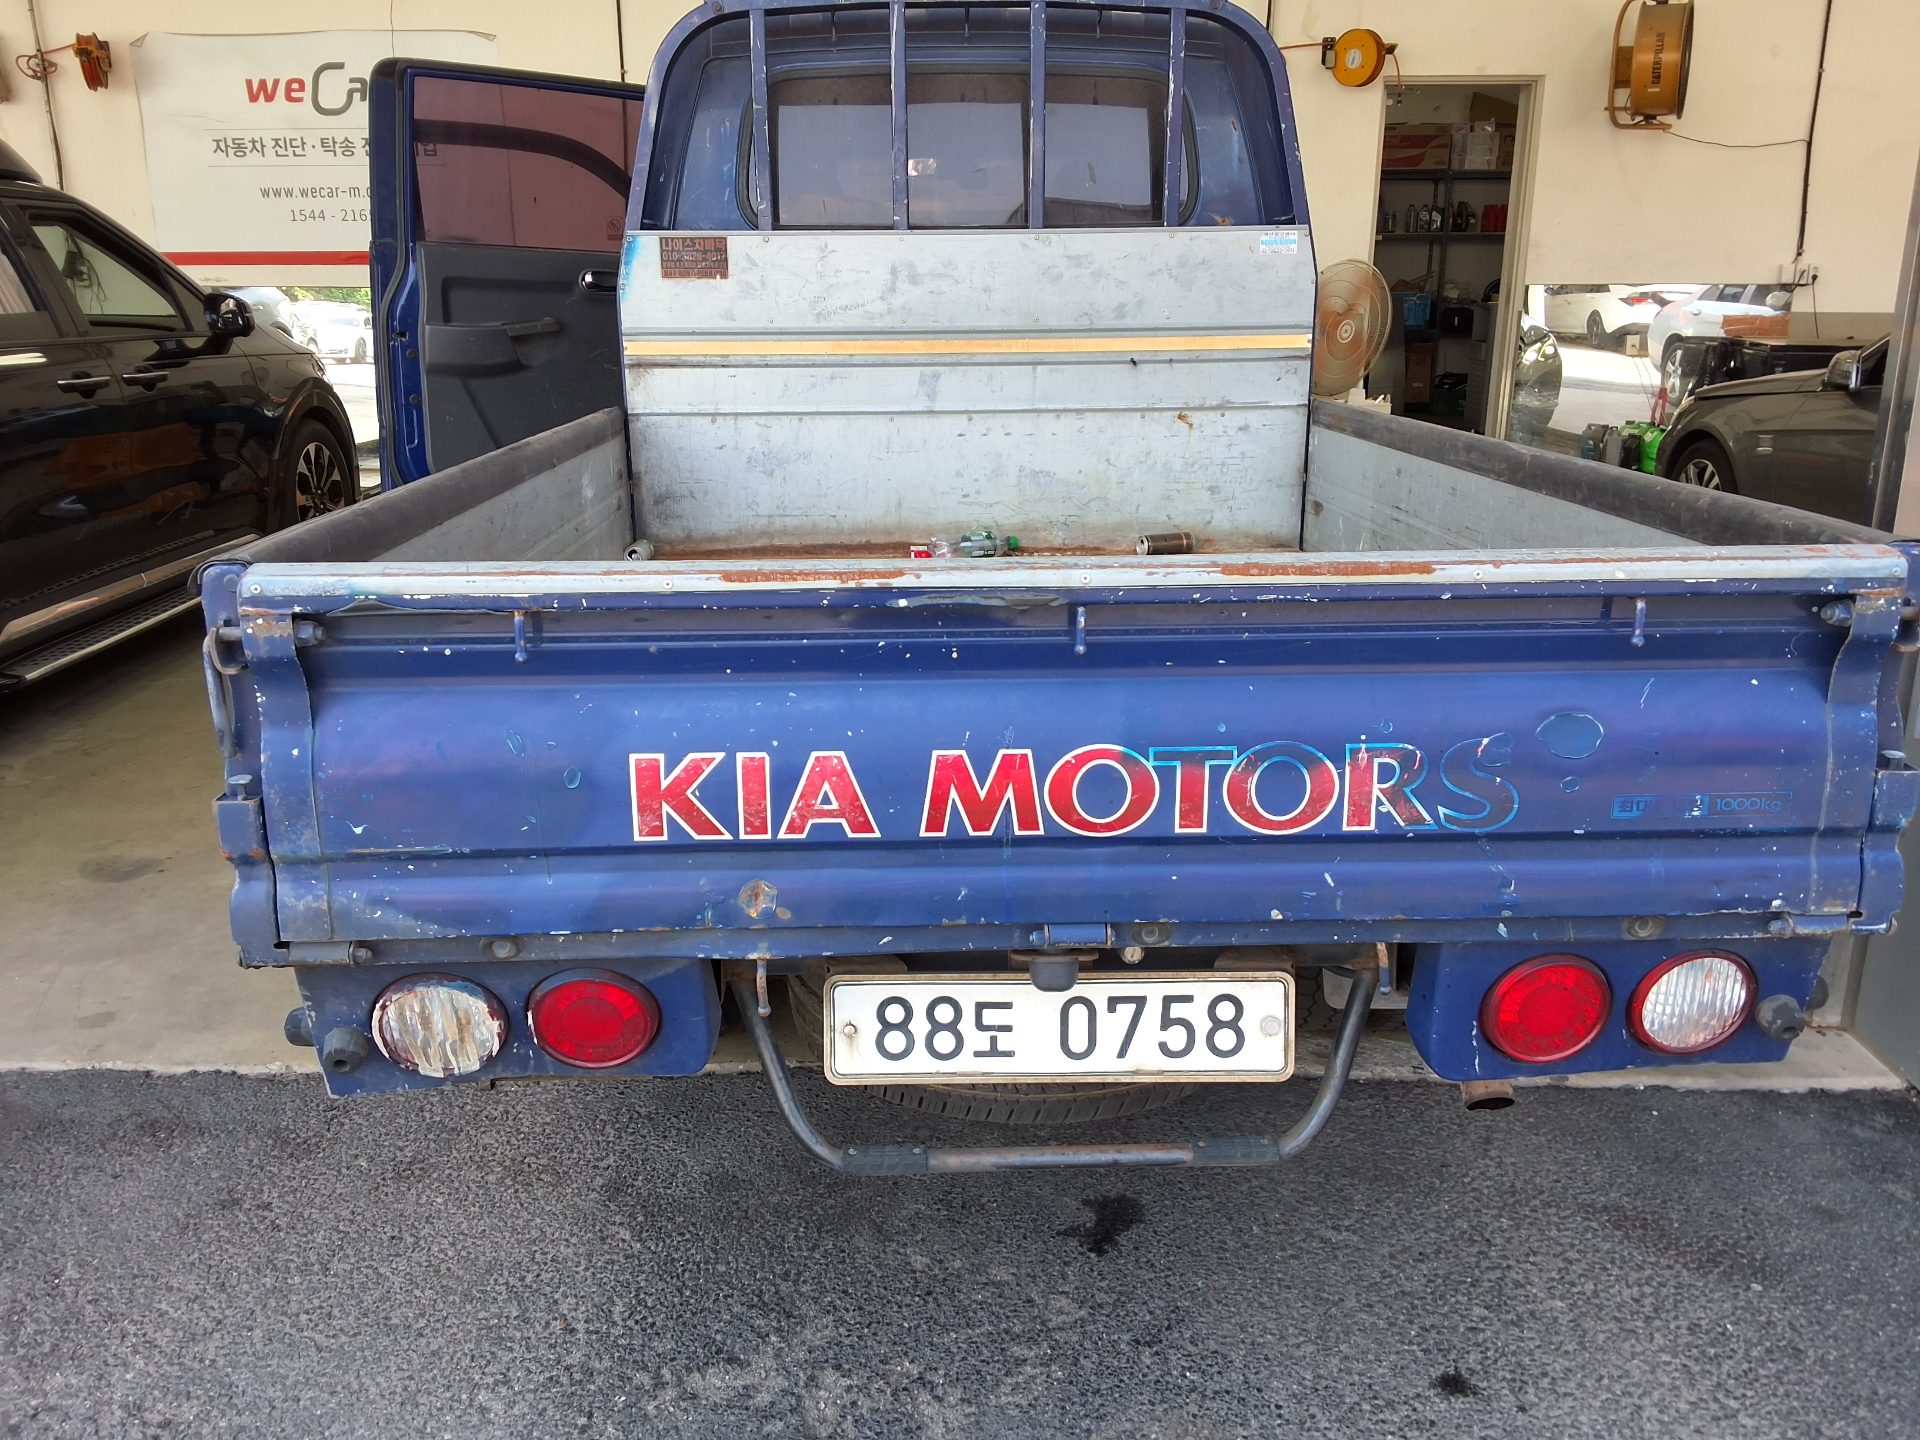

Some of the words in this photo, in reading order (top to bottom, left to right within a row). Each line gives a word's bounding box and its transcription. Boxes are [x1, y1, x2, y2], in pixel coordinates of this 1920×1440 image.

[1651, 32, 1666, 85] CATERPILLAR
[211, 136, 267, 158] 자동차
[628, 750, 881, 842] KIA
[919, 732, 1521, 839] MOTORS
[1715, 796, 1783, 813] 1000kg
[875, 995, 1016, 1061] 88도
[1059, 993, 1246, 1061] 0758
